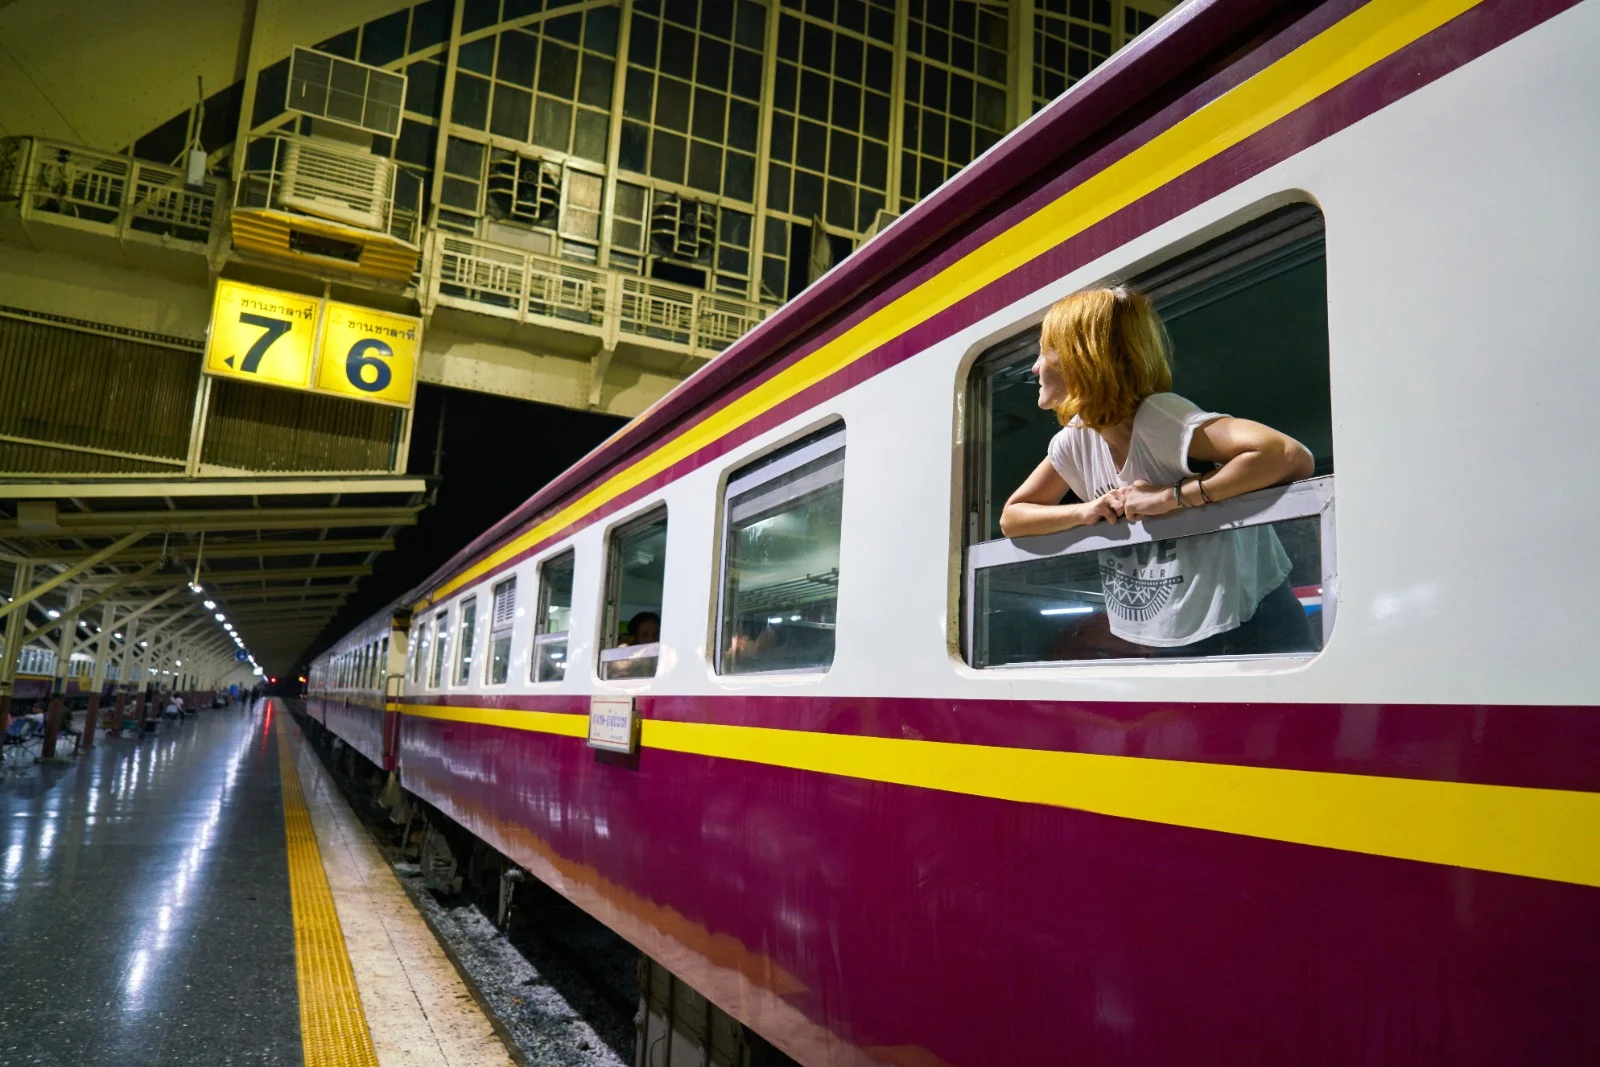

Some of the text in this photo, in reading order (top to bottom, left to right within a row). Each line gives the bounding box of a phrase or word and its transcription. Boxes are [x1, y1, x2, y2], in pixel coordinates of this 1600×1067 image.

[241, 298, 313, 321] ชานชาลาที่
[348, 320, 416, 341] ชานชาลาที่
[239, 312, 293, 374] 7
[345, 338, 394, 392] 6
[1133, 568, 1166, 579] EVER
